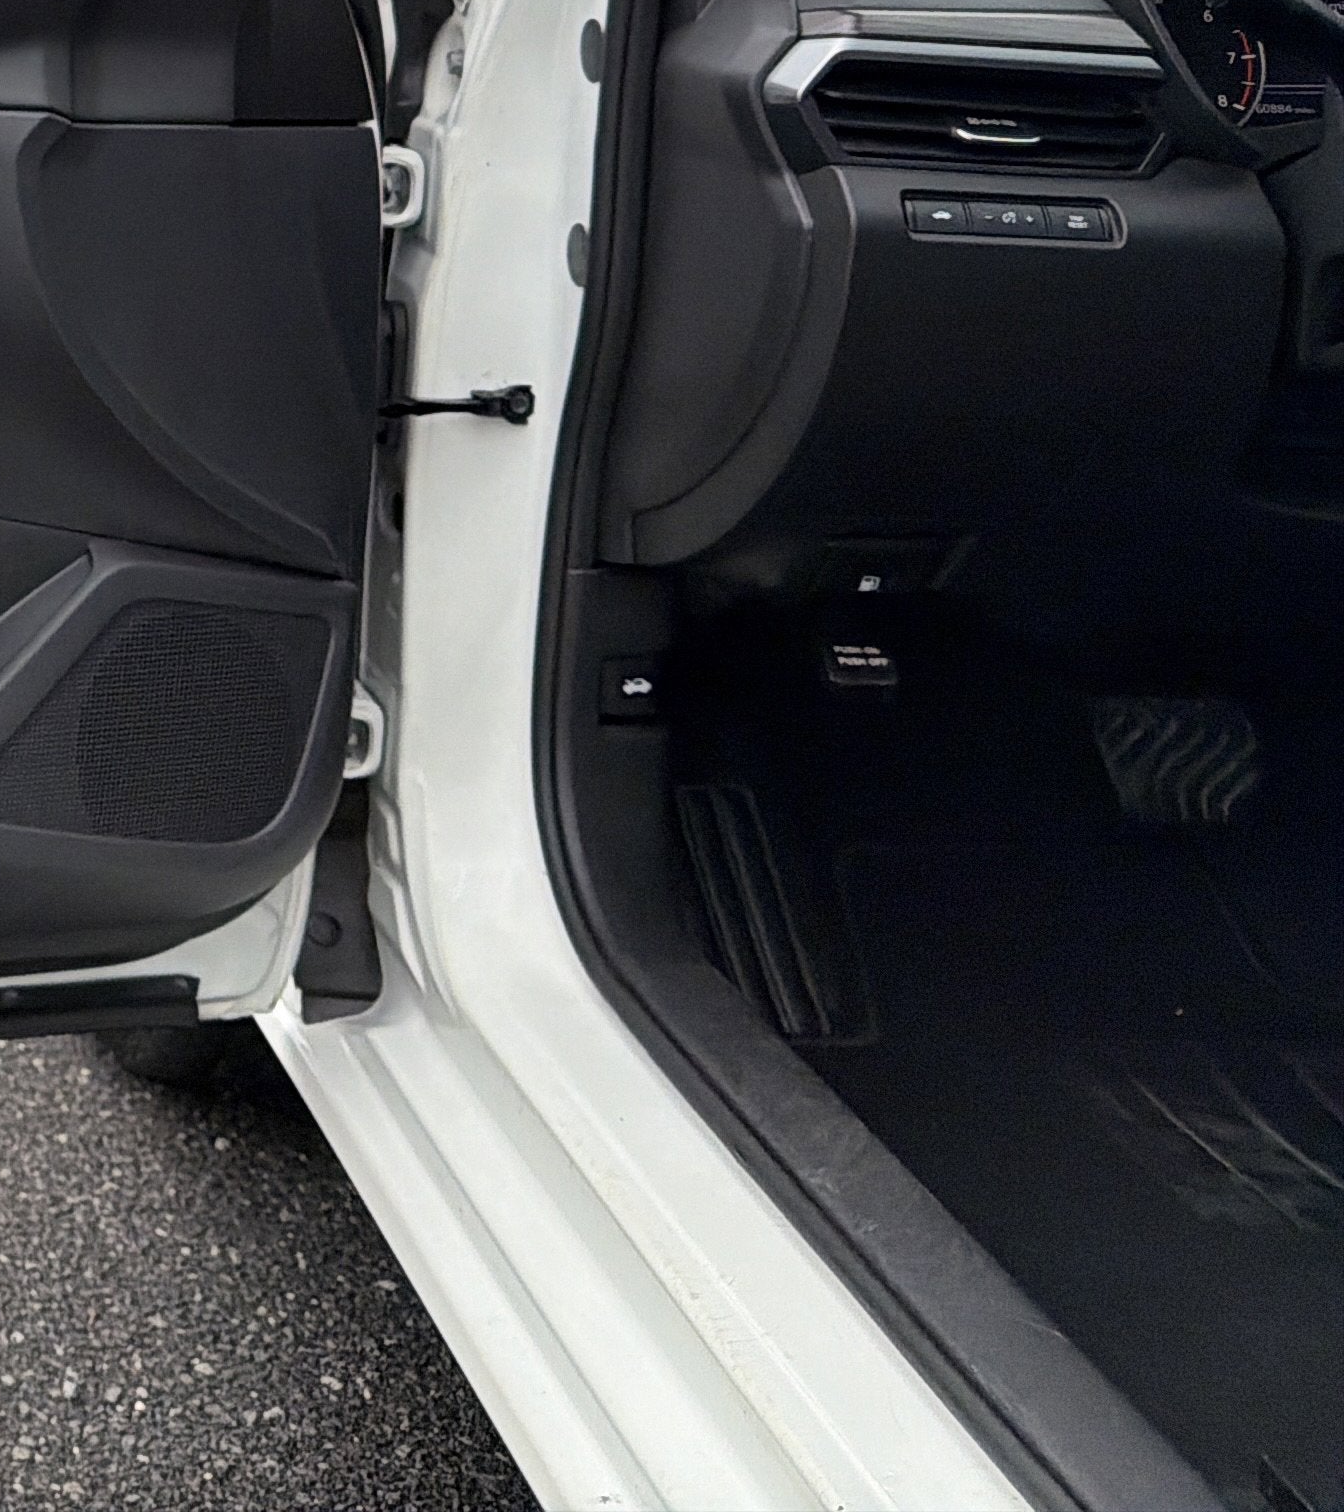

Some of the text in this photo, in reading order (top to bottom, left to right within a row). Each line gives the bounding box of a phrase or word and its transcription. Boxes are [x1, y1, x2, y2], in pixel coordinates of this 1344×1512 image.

[1203, 9, 1214, 23] 6
[1226, 52, 1236, 65] 7
[1217, 94, 1228, 108] 8
